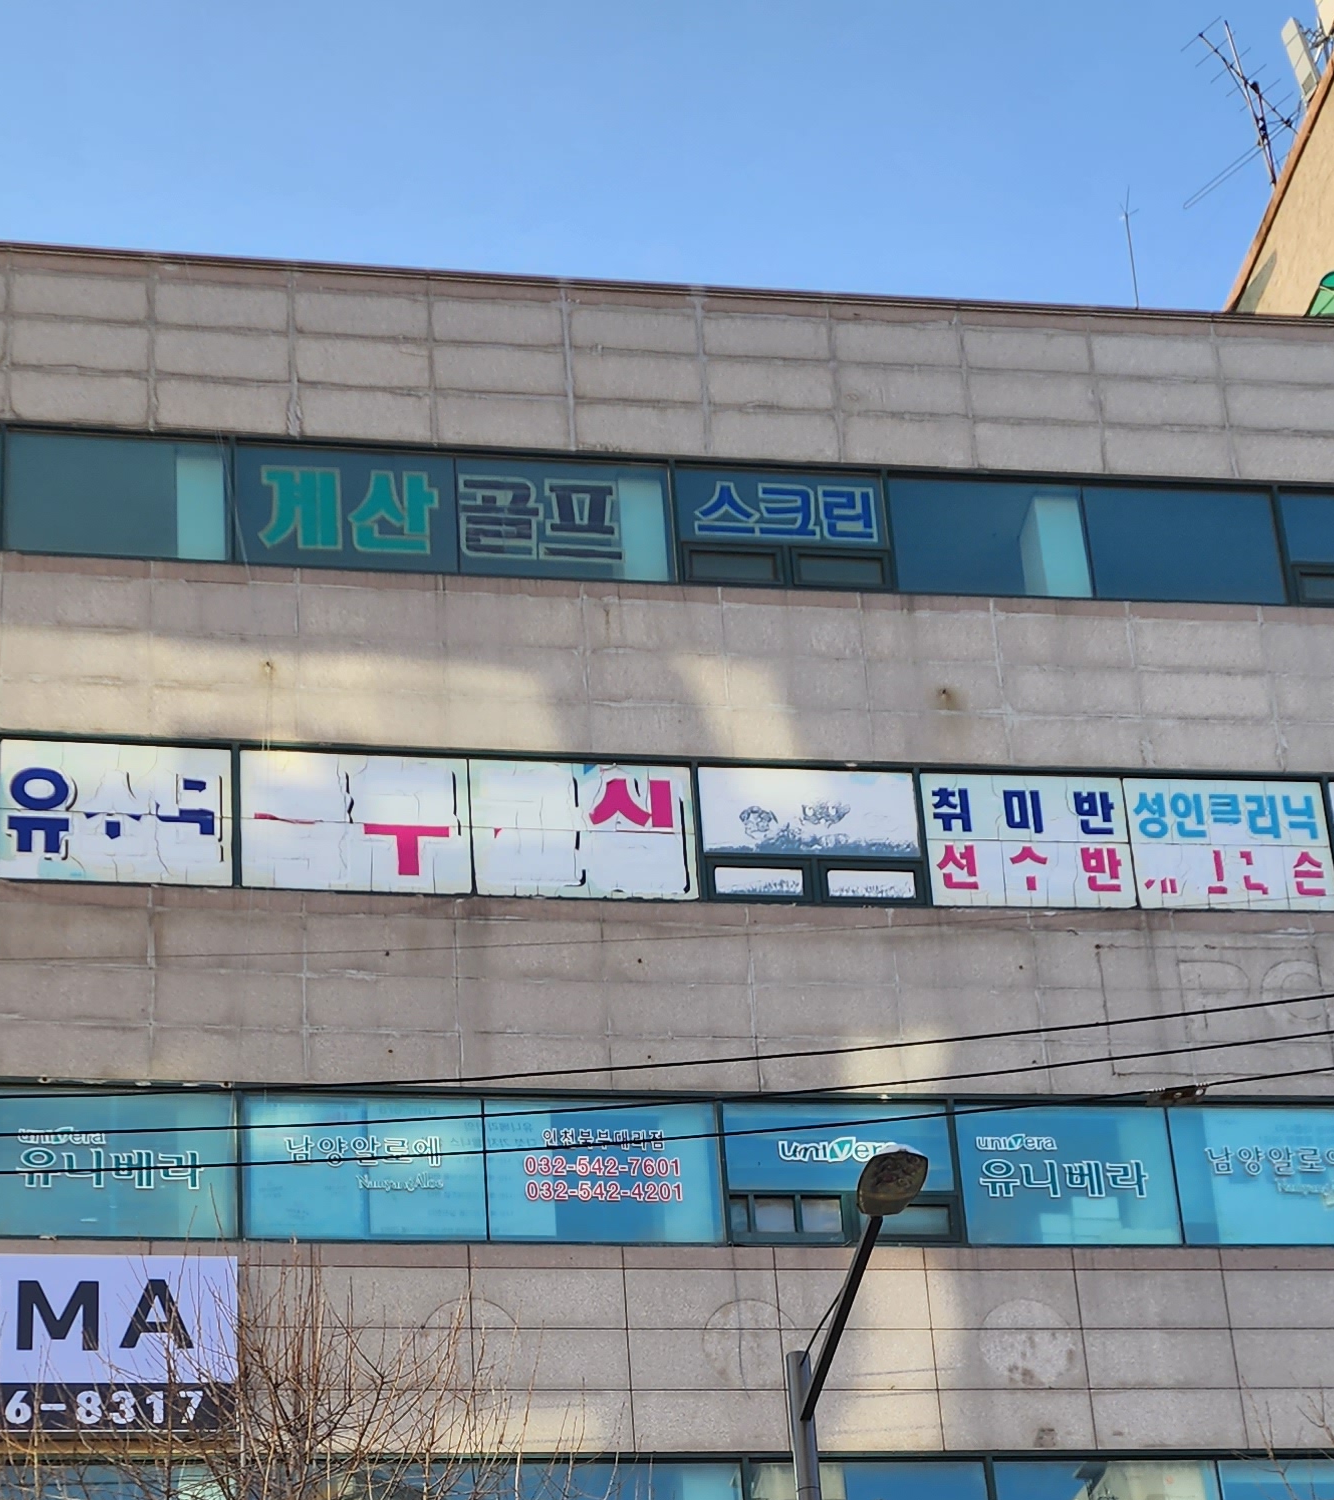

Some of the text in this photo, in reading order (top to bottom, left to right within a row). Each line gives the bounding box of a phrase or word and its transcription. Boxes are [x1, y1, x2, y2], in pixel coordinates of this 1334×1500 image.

[694, 480, 879, 544] 스크린
[778, 1136, 898, 1163] univer
[975, 1133, 1058, 1152] univera
[16, 1147, 204, 1190] 유니베라
[524, 1156, 682, 1177] 032-542-7601
[979, 1158, 1149, 1198] 유니베라
[525, 1180, 684, 1202] 032-542-4201
